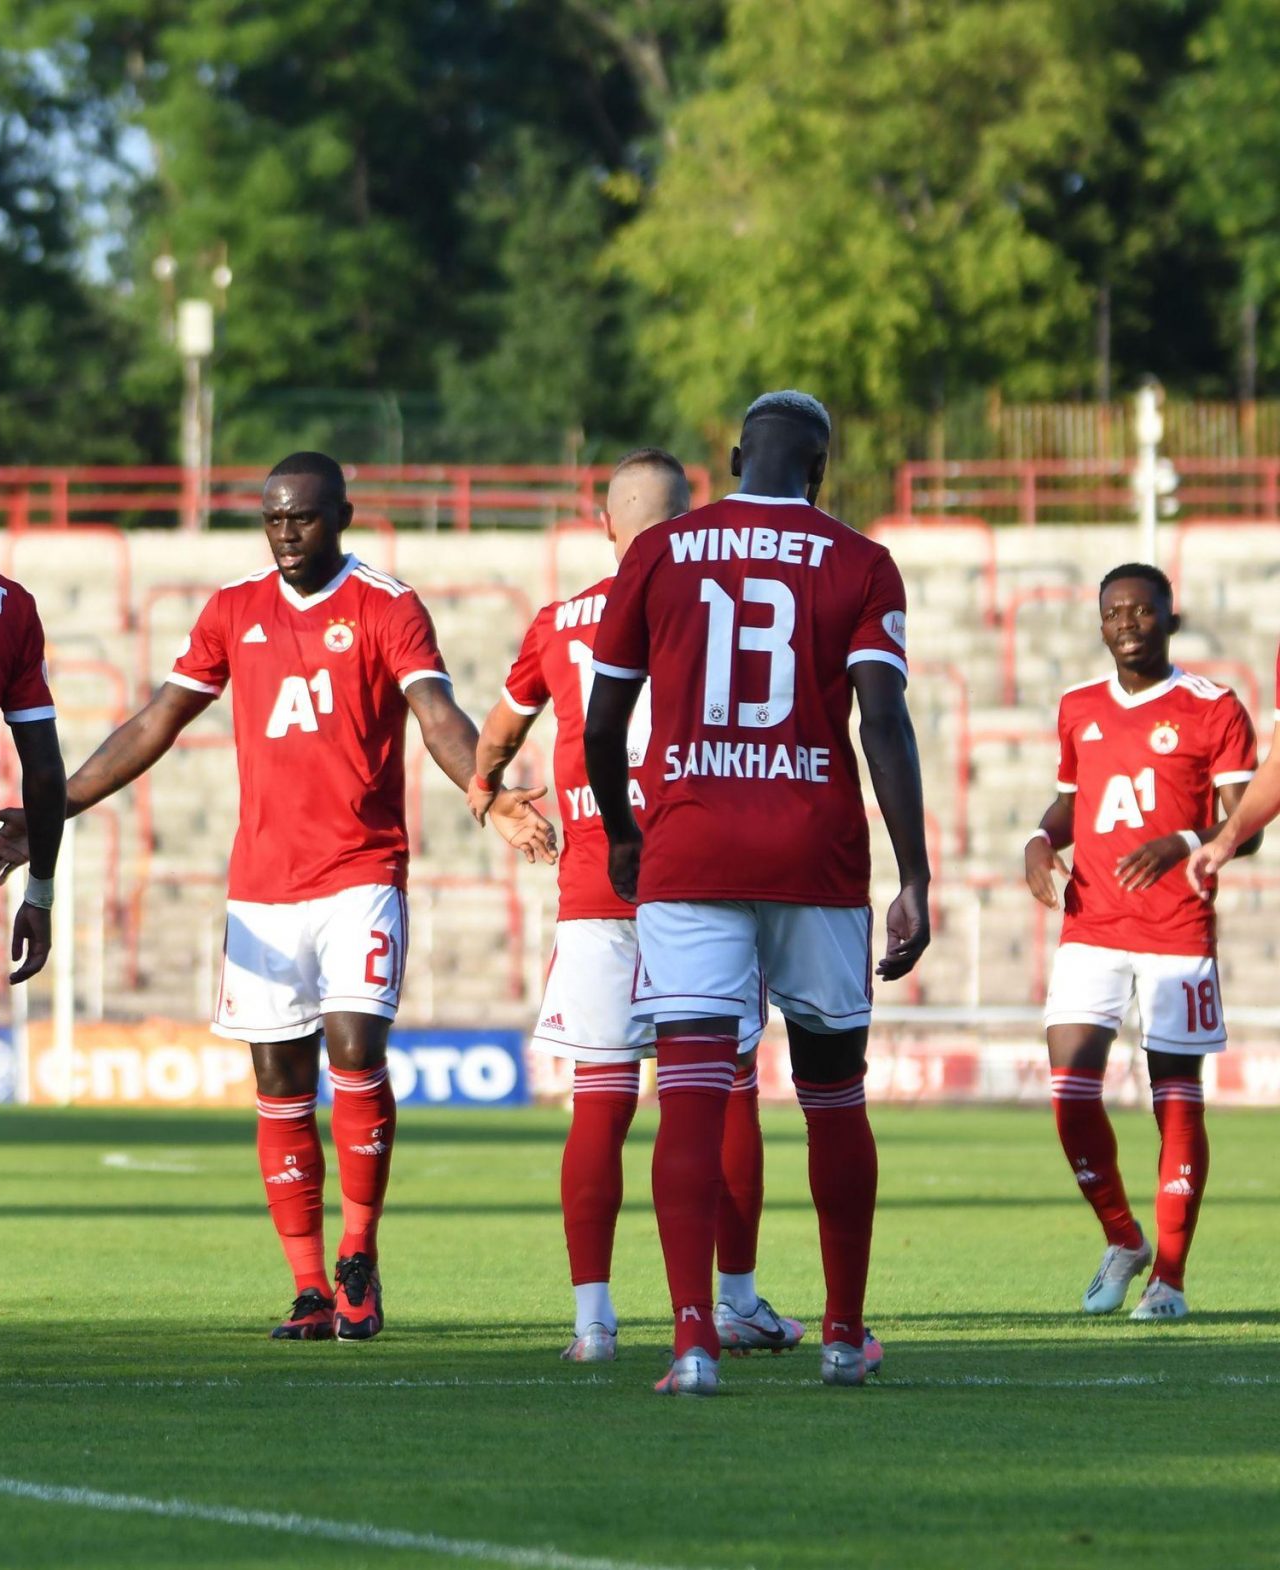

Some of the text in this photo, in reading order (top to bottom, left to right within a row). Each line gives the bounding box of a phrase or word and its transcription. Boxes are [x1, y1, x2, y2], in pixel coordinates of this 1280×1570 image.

[670, 526, 834, 568] WINBET
[699, 577, 796, 728] 13
[265, 668, 333, 739] A1
[663, 740, 830, 783] SANKHARE
[1094, 766, 1156, 835] A1
[365, 929, 399, 990] 21
[1182, 979, 1218, 1032] 18
[38, 1046, 251, 1100] СПОР
[385, 1046, 517, 1101] ОТО
[284, 1155, 297, 1166] 21
